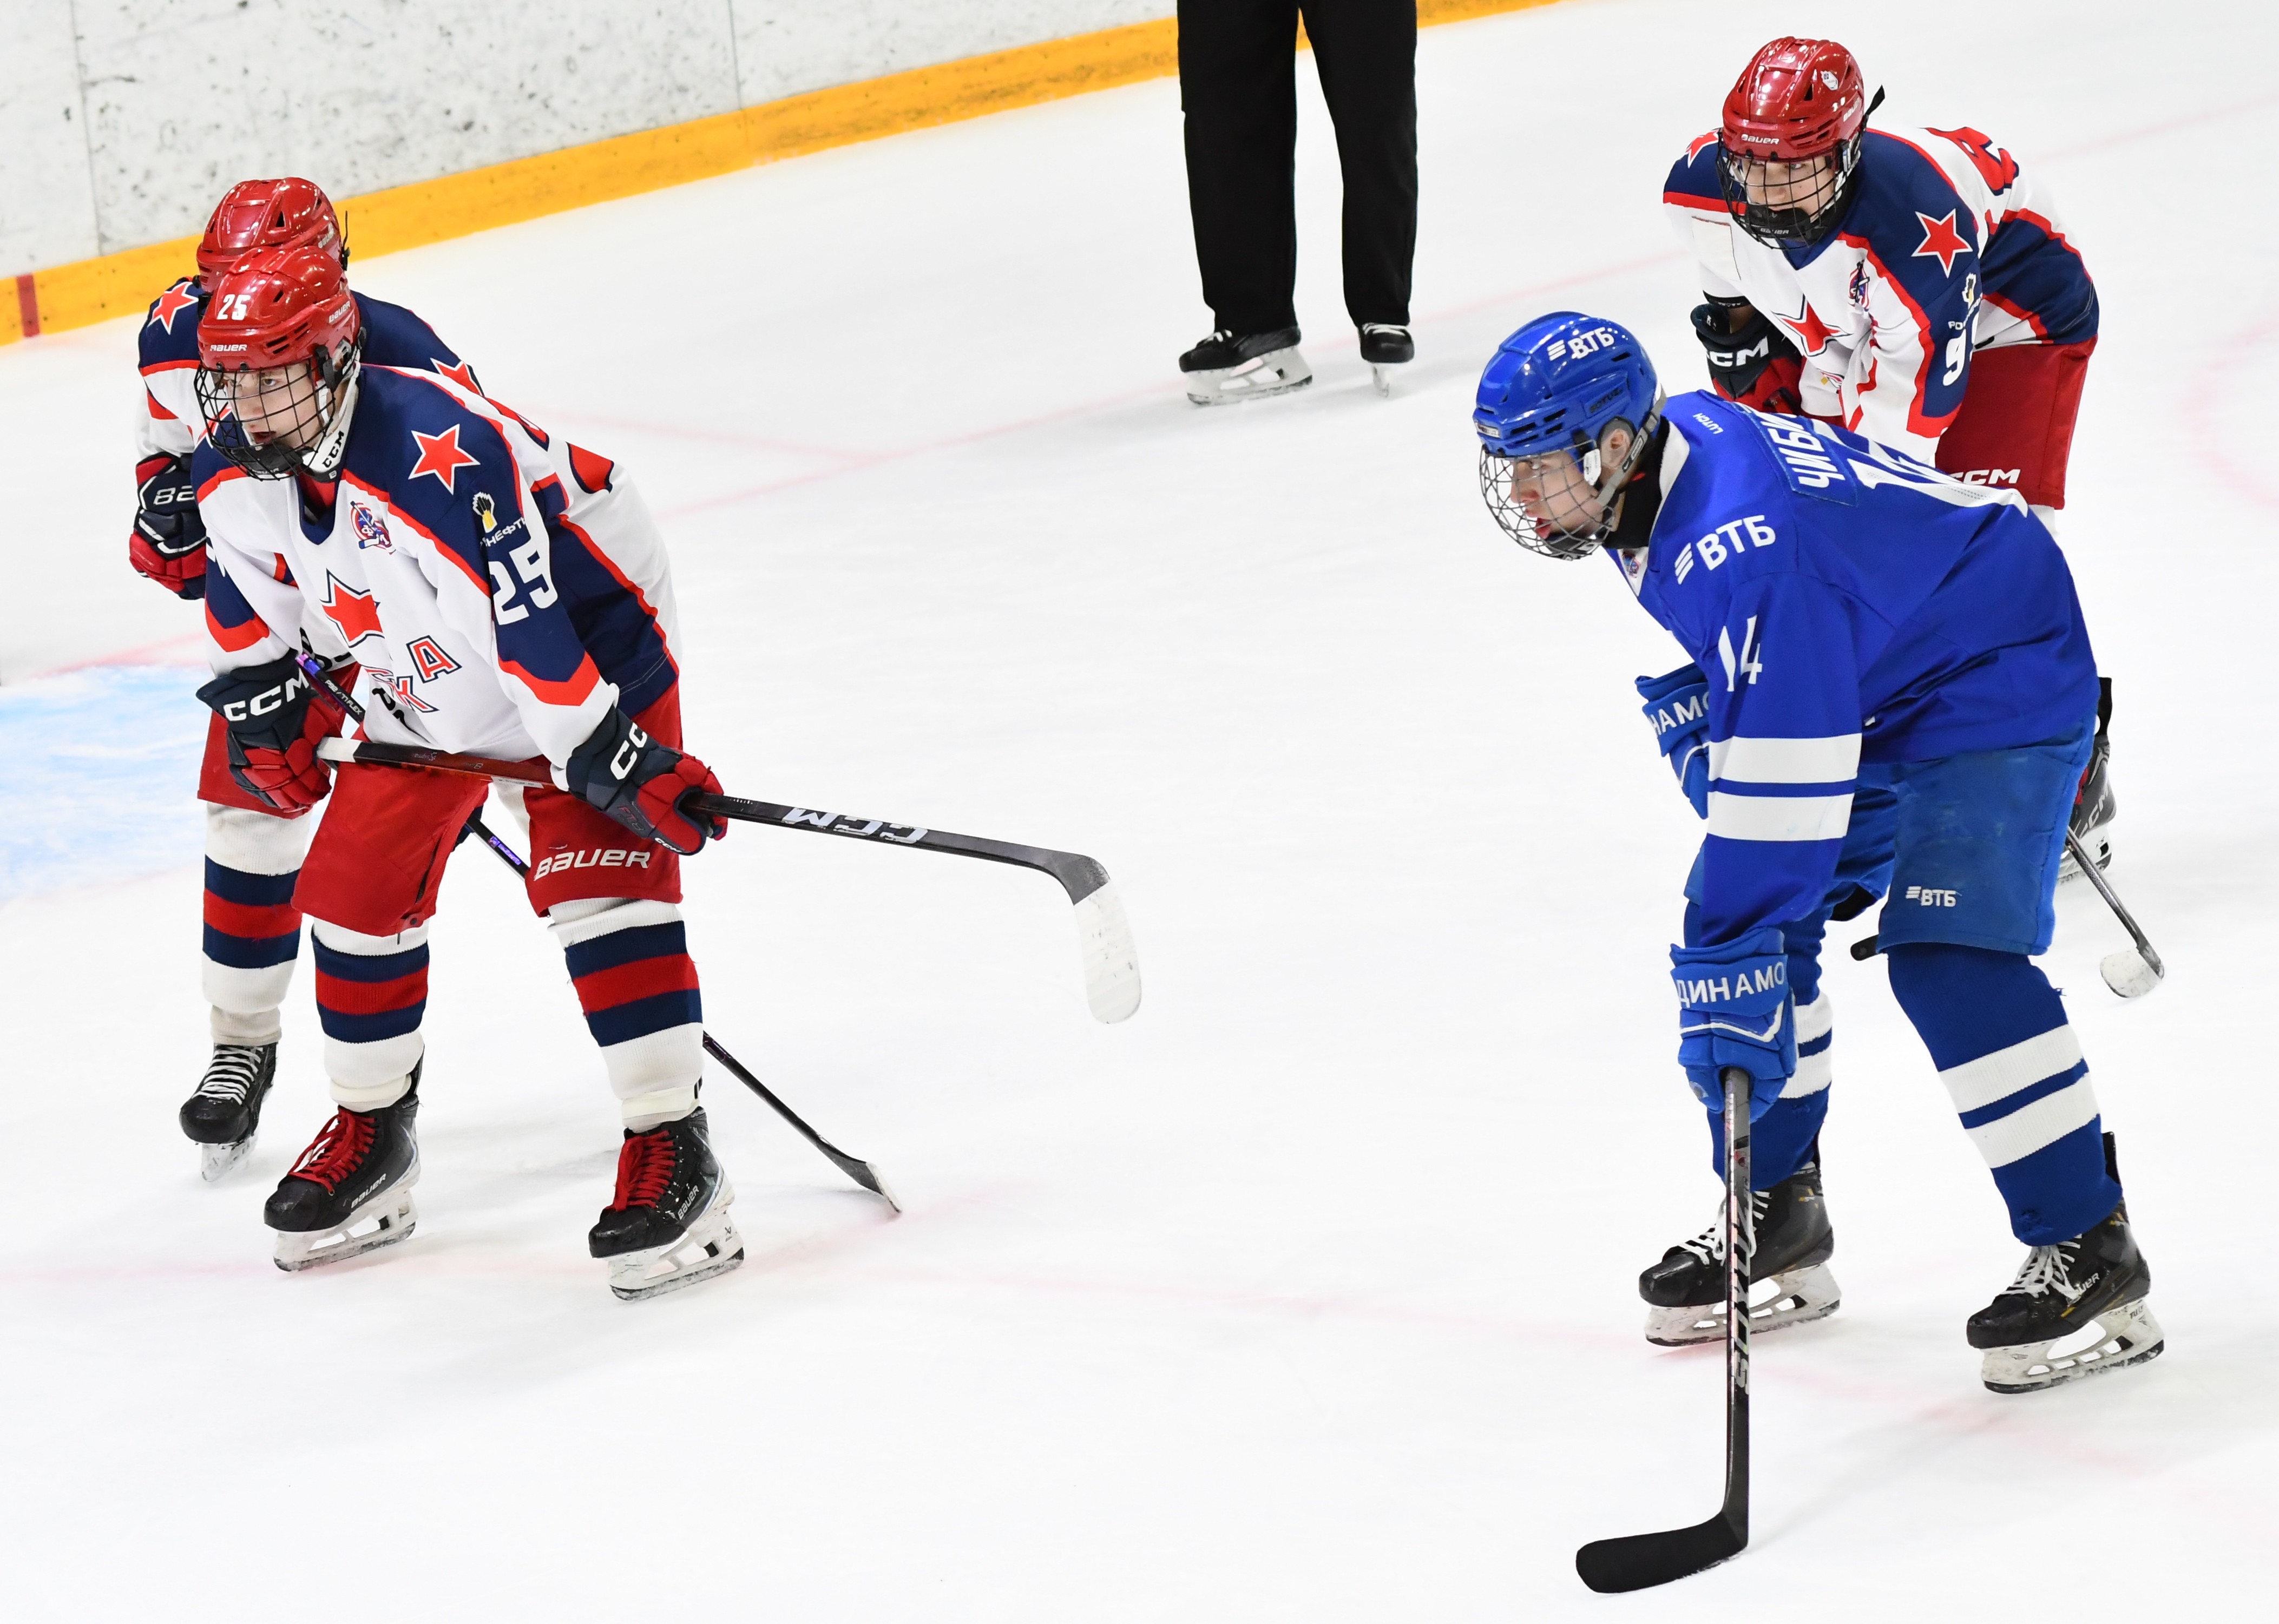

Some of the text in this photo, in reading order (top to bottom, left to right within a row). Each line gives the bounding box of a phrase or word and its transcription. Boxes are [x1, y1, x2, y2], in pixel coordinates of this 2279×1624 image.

[1741, 134, 1779, 144] BAUER
[216, 294, 251, 320] 25
[329, 300, 351, 323] BAUER
[1568, 327, 1615, 359] ВТБ
[1706, 335, 1769, 367] CM
[1693, 412, 1724, 435] LUTCH
[321, 430, 345, 468] CCM
[1696, 515, 1776, 571] ВТБ
[488, 538, 559, 626] 25
[1718, 615, 1763, 692] 14
[223, 673, 310, 722] CCM
[346, 699, 363, 715] FLEX
[610, 722, 648, 780] CC
[782, 806, 928, 844] CCM
[534, 848, 651, 882] BAUER
[1921, 889, 1956, 907] ВТБ
[1676, 962, 1785, 1008] ДИНАМО
[351, 1173, 386, 1209] BAUER
[678, 1184, 700, 1221] BAUER
